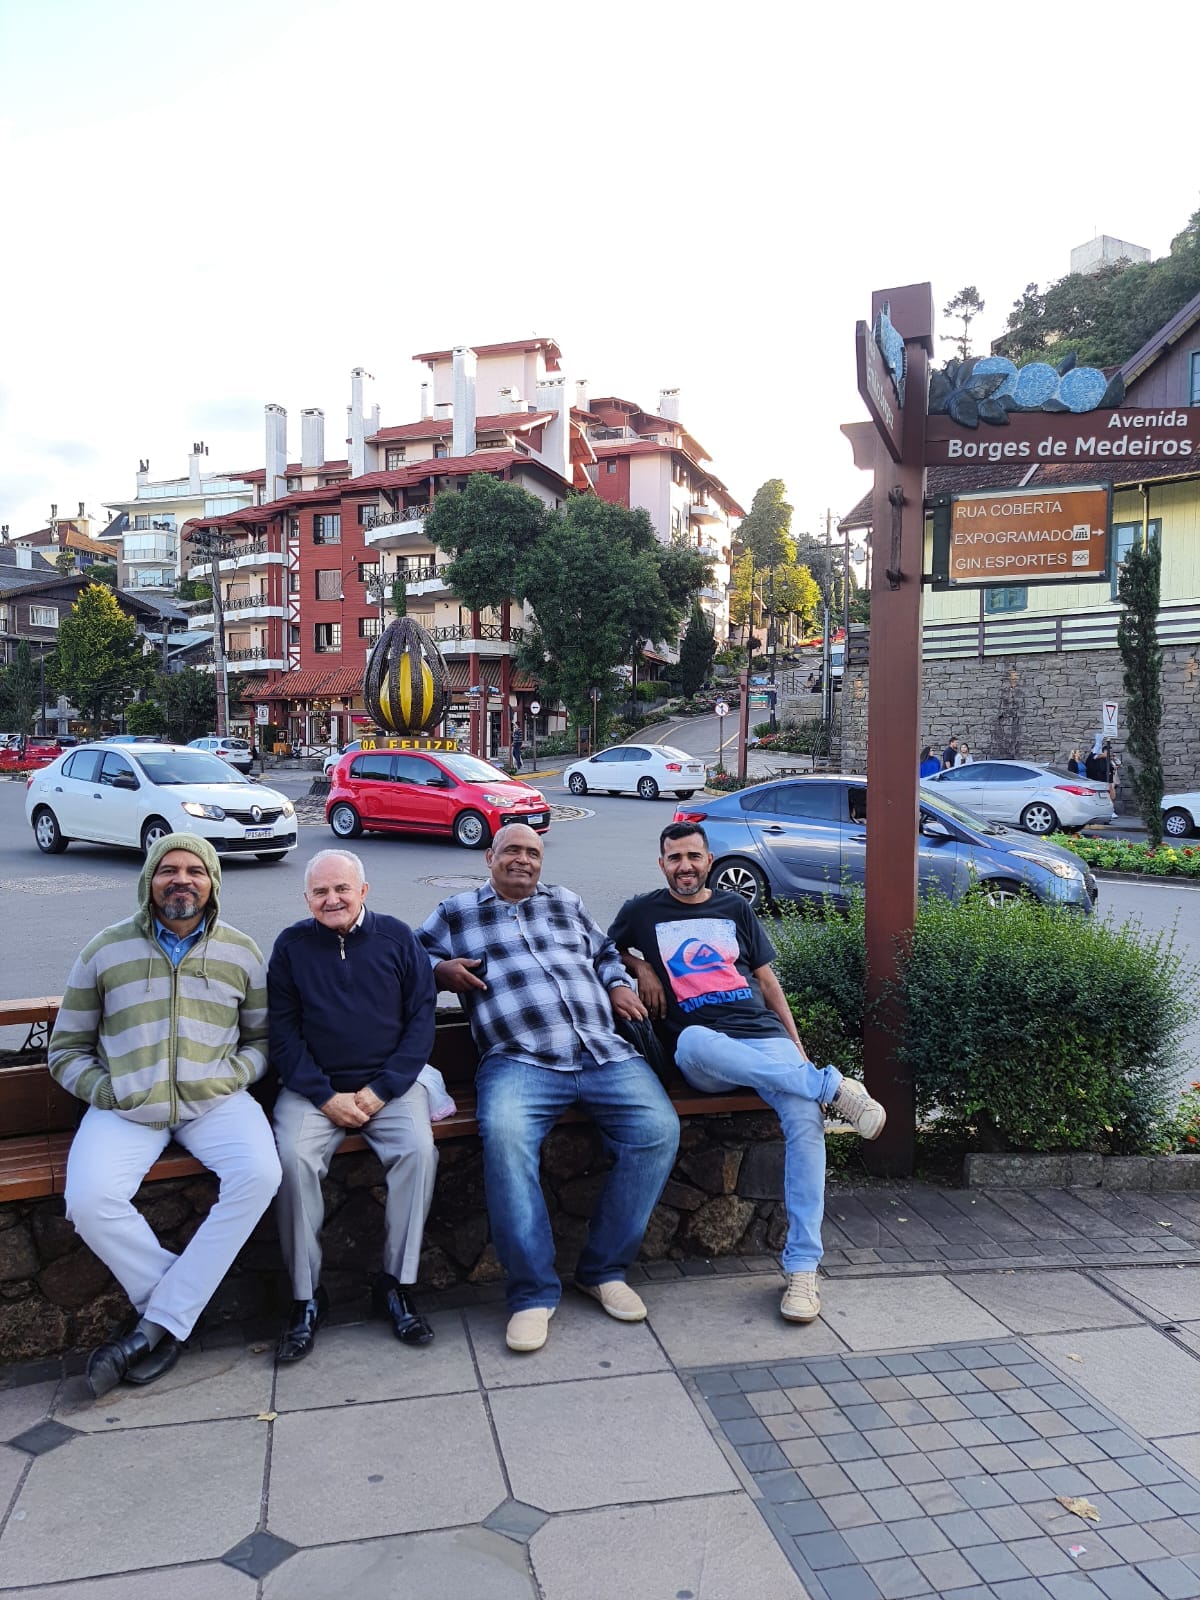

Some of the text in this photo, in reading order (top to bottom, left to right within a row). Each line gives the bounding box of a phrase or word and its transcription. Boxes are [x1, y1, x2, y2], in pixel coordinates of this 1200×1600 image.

[1107, 410, 1188, 428] Avenida
[947, 435, 1193, 461] Borges de Medeiros
[956, 501, 1063, 518] RUA COBERTA
[954, 529, 1074, 545] EXPOGRAMADO
[389, 740, 442, 750] FELIZ
